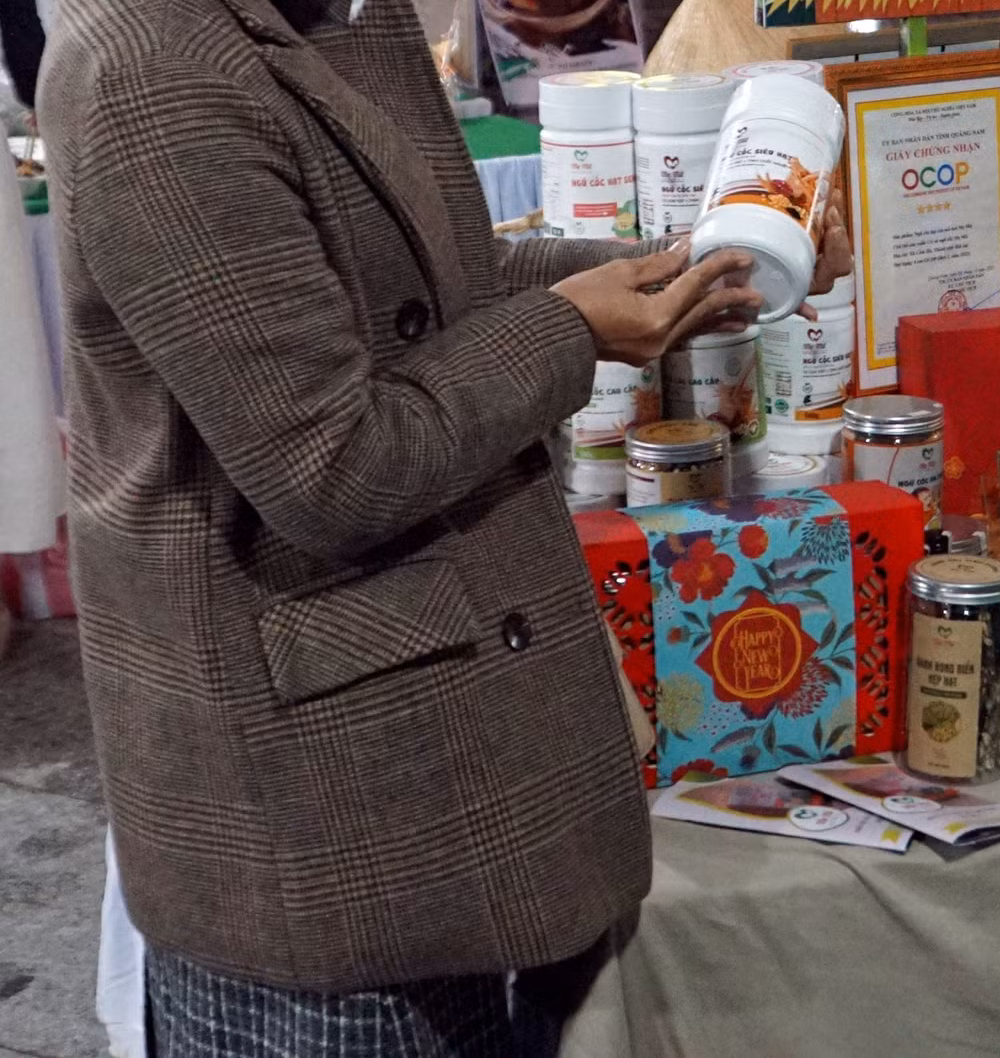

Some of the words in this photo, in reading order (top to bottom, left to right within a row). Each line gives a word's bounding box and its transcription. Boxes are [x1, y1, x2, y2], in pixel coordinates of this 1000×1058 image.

[902, 161, 970, 191] OCOP
[739, 630, 774, 650] HAPPY
[741, 648, 768, 665] NEW
[743, 663, 772, 690] YEAR
